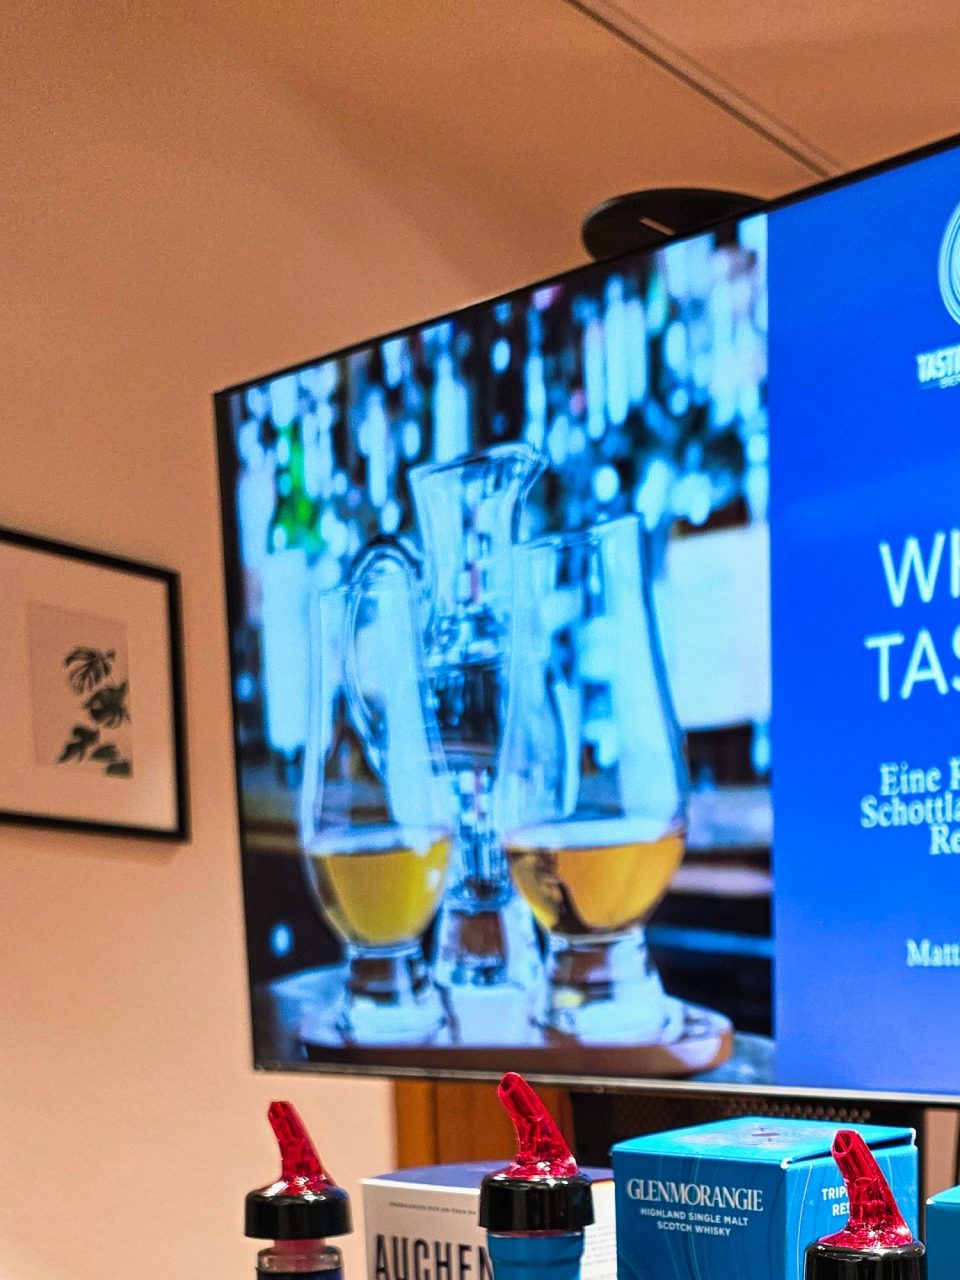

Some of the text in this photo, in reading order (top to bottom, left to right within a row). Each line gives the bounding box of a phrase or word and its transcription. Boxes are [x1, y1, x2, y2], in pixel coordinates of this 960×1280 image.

[879, 760, 941, 796] Eine
[627, 1178, 763, 1212] GLENMORANGIE
[640, 1207, 749, 1226] HIGHLAND SINGLE MALT
[657, 1221, 731, 1236] SCOTCH WHISKY
